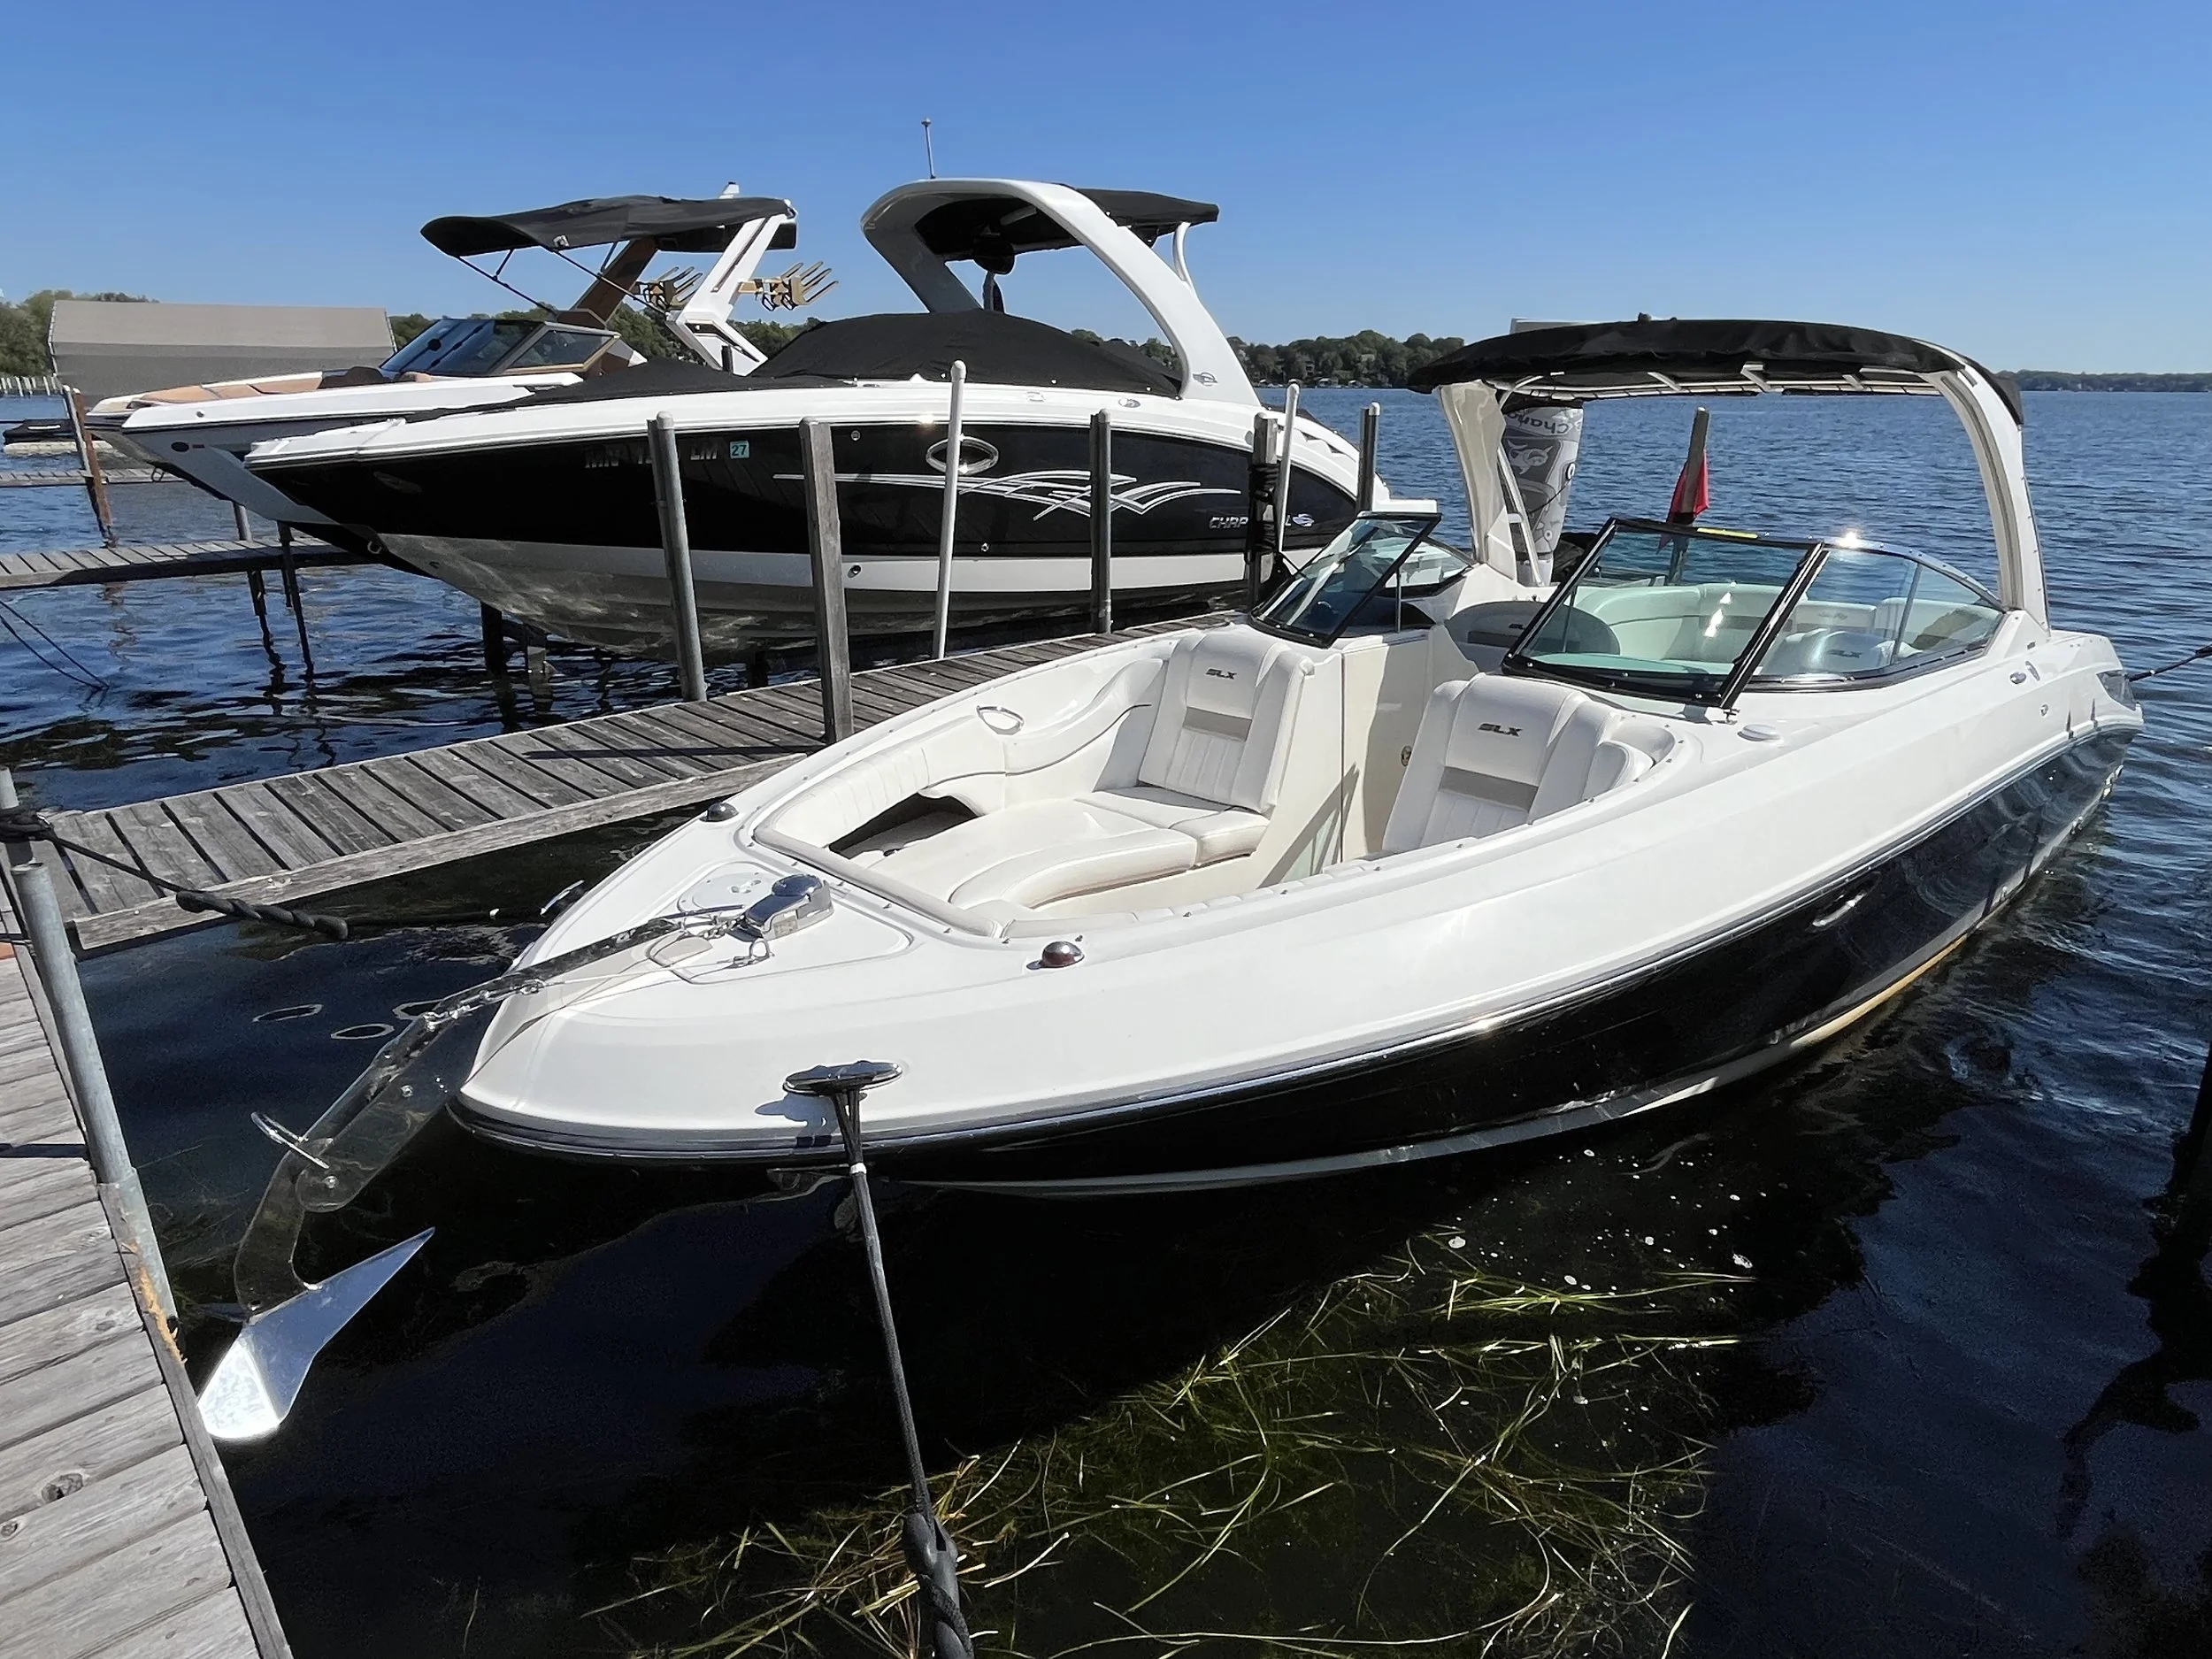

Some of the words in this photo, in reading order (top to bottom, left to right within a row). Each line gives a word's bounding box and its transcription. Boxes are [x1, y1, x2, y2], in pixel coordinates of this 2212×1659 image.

[731, 444, 747, 457] 27
[1209, 515, 1292, 529] CHAPL
[1205, 668, 1237, 680] SLX
[1478, 723, 1524, 737] SLX
